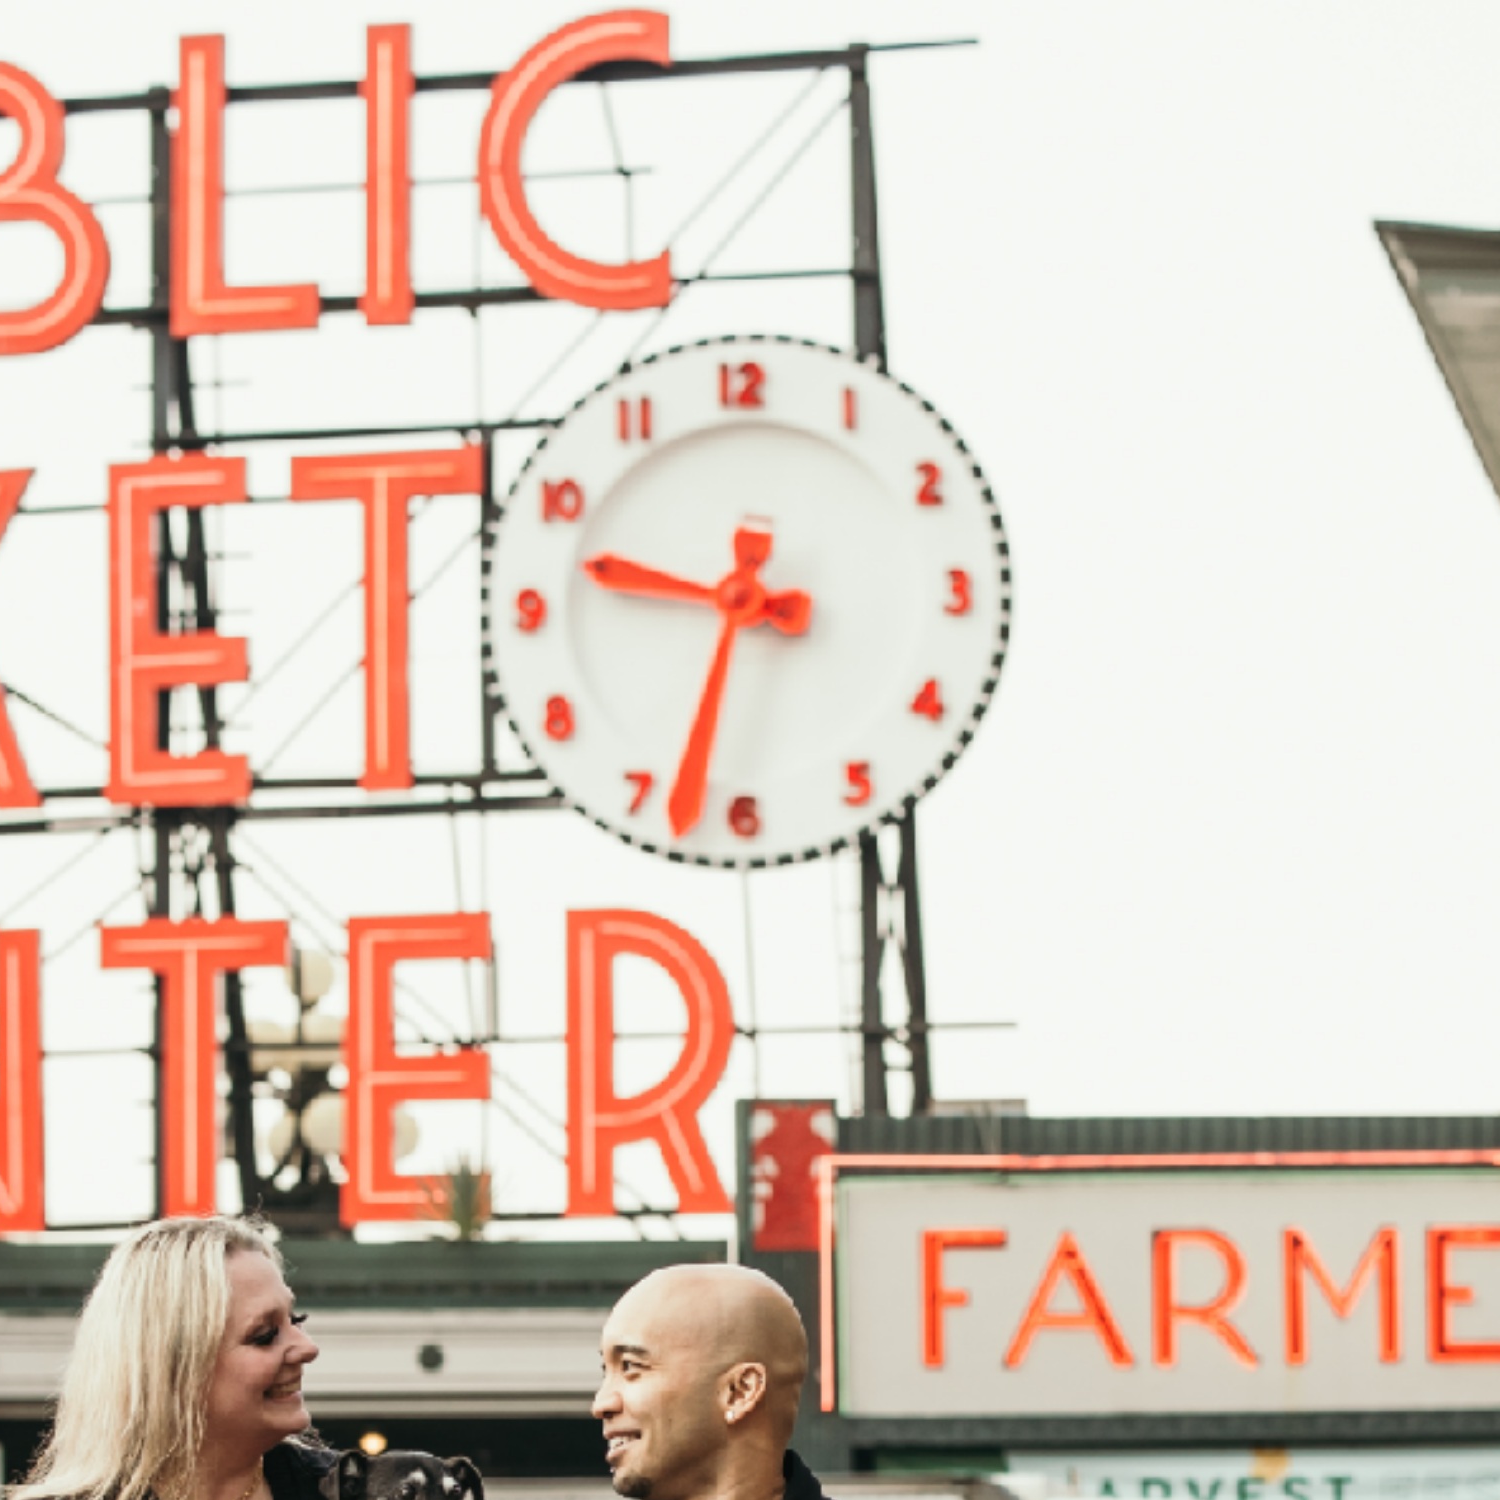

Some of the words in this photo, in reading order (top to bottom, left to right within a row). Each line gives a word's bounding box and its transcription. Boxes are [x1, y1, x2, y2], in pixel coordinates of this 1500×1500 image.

[717, 361, 767, 410] 12
[616, 397, 653, 442] 11
[841, 388, 857, 430] 1
[538, 478, 584, 523] 10
[913, 460, 944, 508] 2
[513, 587, 549, 635] 9
[943, 567, 974, 618] 3
[542, 693, 577, 743] 8
[908, 677, 945, 723] 4
[623, 769, 656, 813] 7
[843, 761, 873, 808] 5
[726, 795, 763, 840] 6
